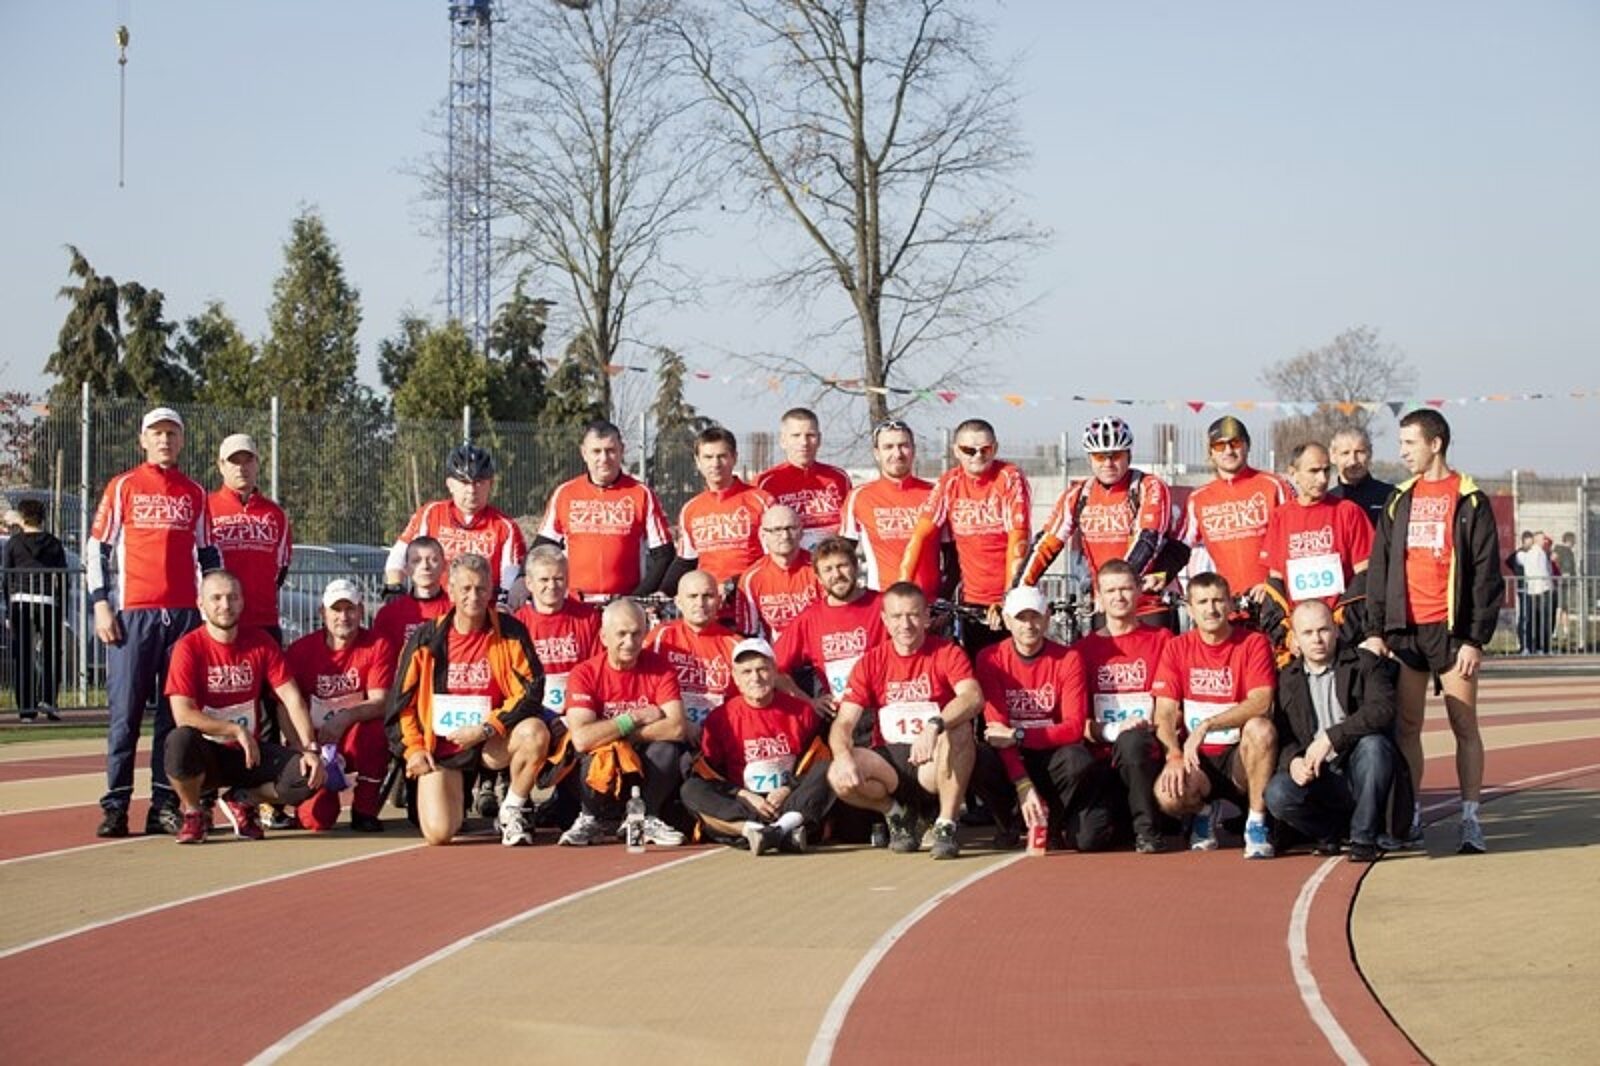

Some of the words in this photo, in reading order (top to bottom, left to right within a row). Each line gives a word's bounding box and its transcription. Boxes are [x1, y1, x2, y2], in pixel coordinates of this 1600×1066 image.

[133, 505, 193, 522] SZPIKU
[569, 510, 634, 525] SZPIKU
[1202, 509, 1268, 531] SZPIKU
[212, 524, 278, 543] SZPIKU
[1295, 569, 1334, 590] 639
[675, 666, 730, 687] ZPIKU
[896, 718, 923, 734] 13
